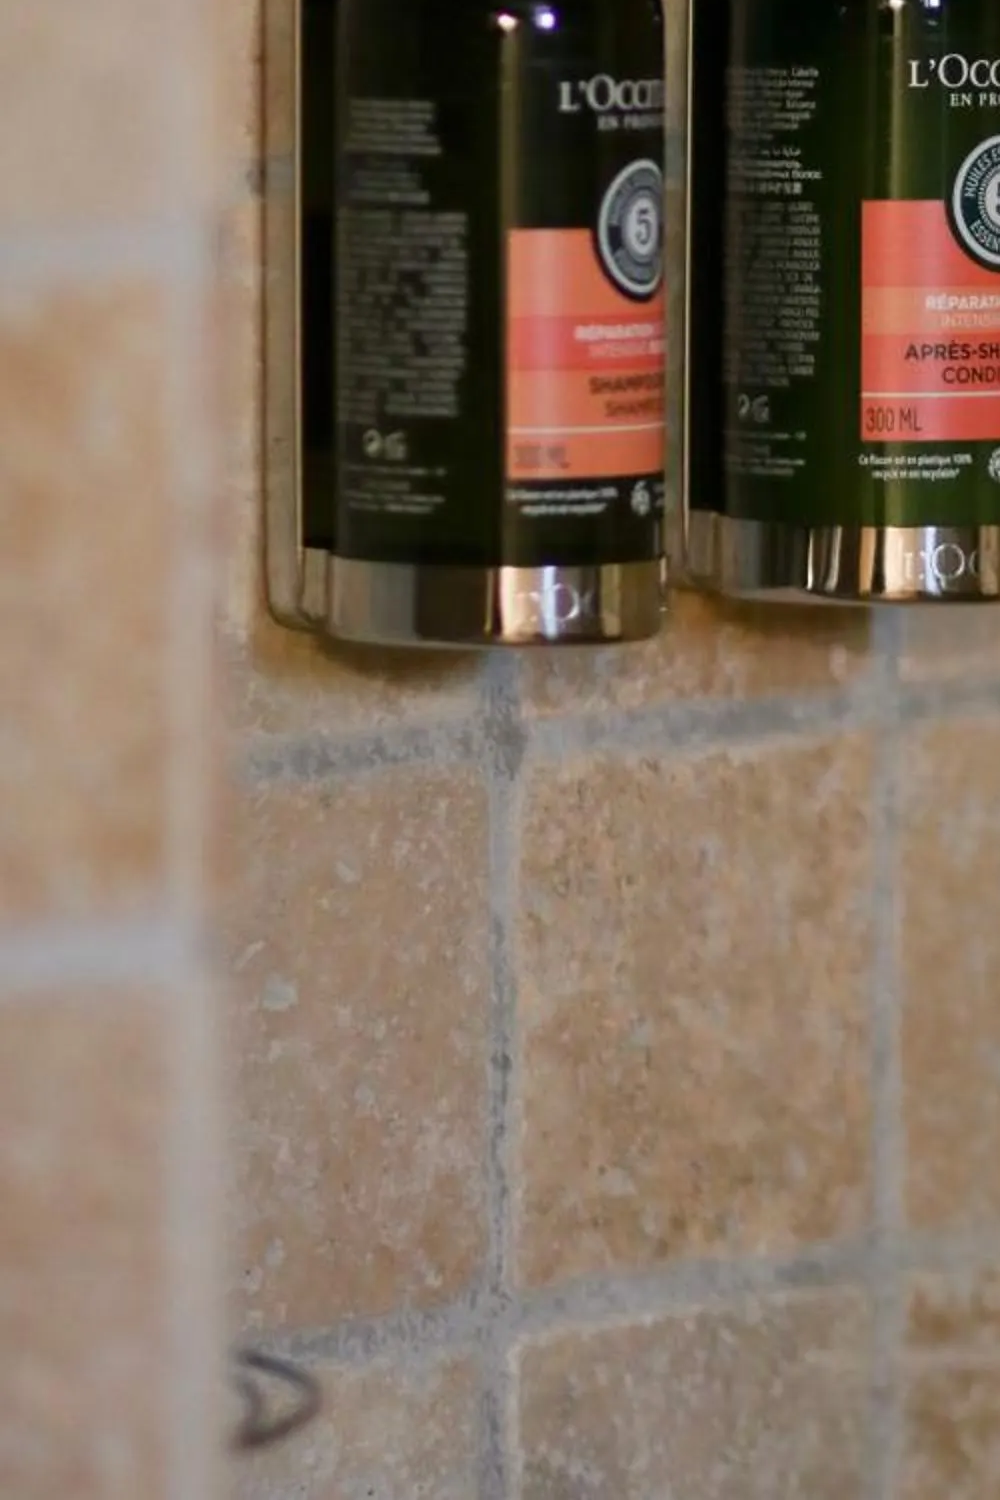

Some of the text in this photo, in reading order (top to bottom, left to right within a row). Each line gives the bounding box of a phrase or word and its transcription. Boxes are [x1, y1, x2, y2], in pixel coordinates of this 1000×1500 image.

[951, 92, 972, 107] EN
[635, 207, 650, 246] 5
[865, 405, 923, 432] 300 ML
